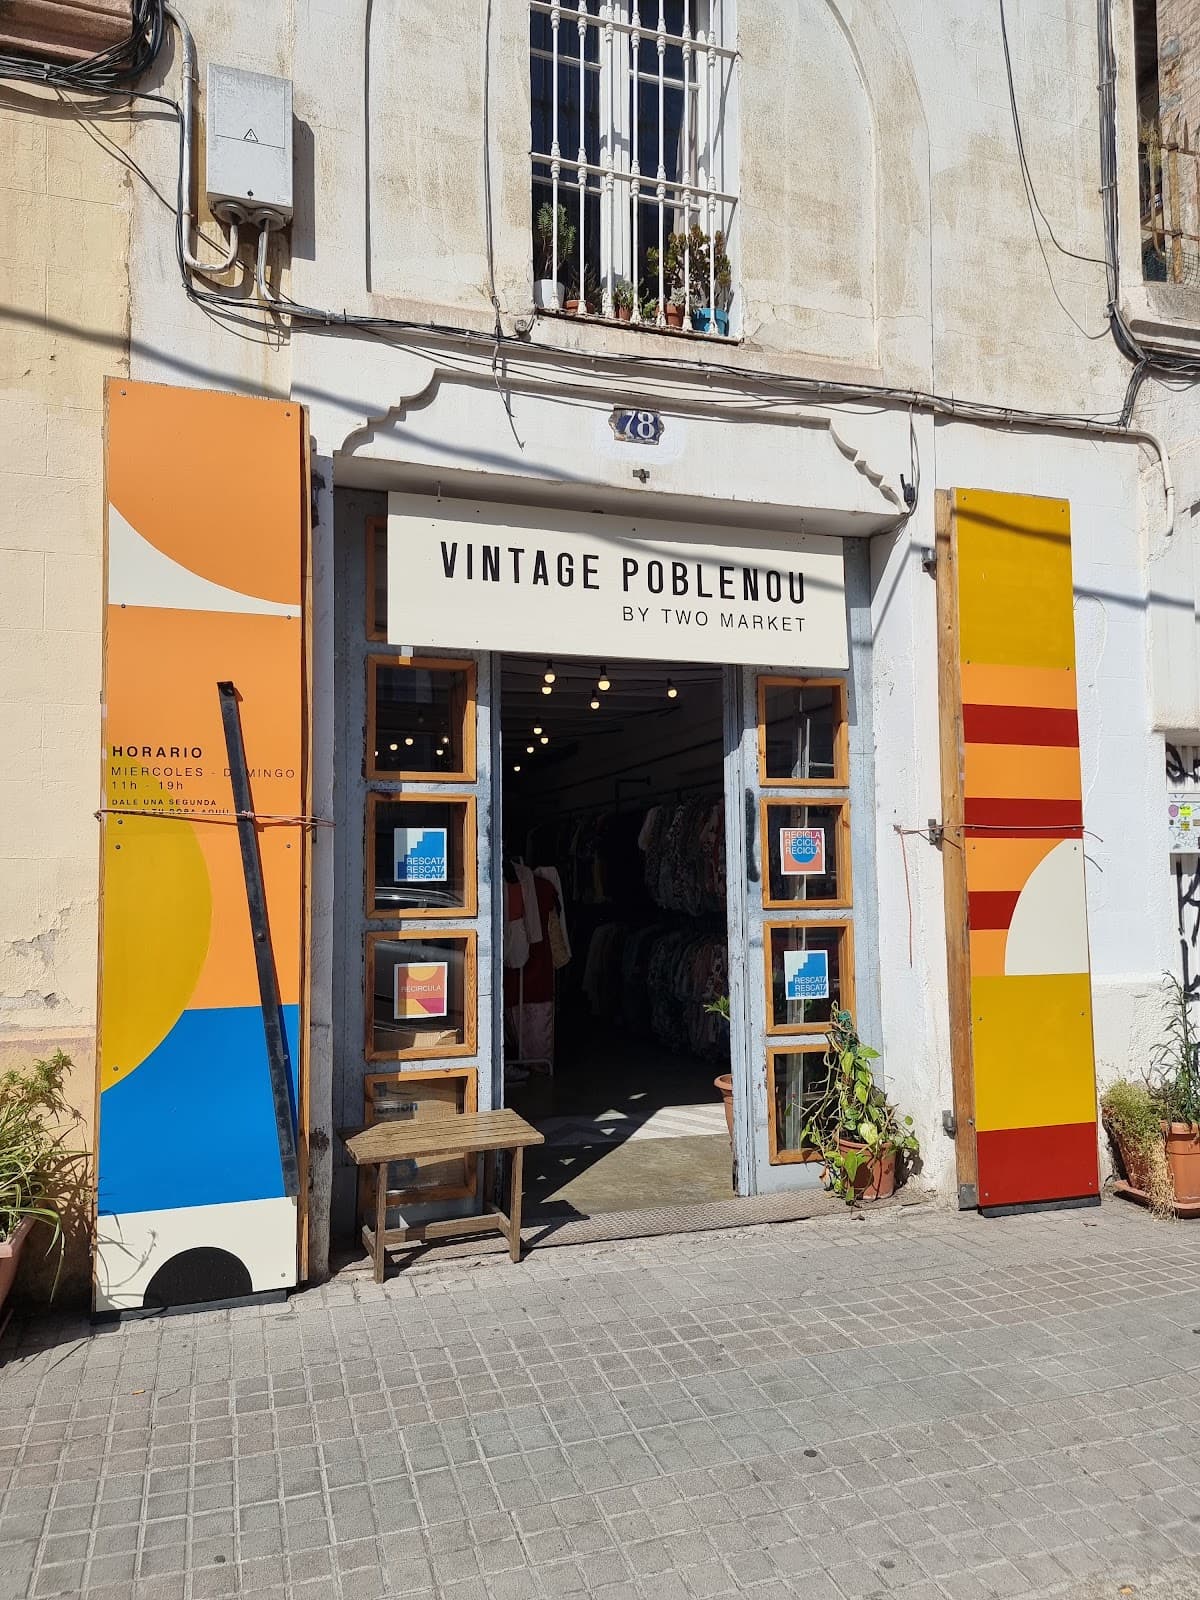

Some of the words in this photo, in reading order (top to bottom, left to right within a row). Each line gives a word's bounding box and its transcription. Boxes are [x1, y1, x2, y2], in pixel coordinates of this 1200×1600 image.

[621, 410, 655, 439] 78
[440, 541, 600, 590] VINTAGE
[622, 557, 805, 604] POBLENOU
[622, 606, 650, 622] BY
[661, 608, 709, 627] TWO
[720, 612, 806, 633] MARKET
[112, 745, 202, 759] HORARIO
[111, 766, 203, 777] MIERCOLES
[223, 767, 295, 779] DMINGO
[112, 781, 137, 790] 11h
[159, 781, 183, 790] 19h
[784, 830, 821, 839] RECICLA
[785, 838, 821, 847] RECICLA
[785, 846, 821, 855] RECICLA
